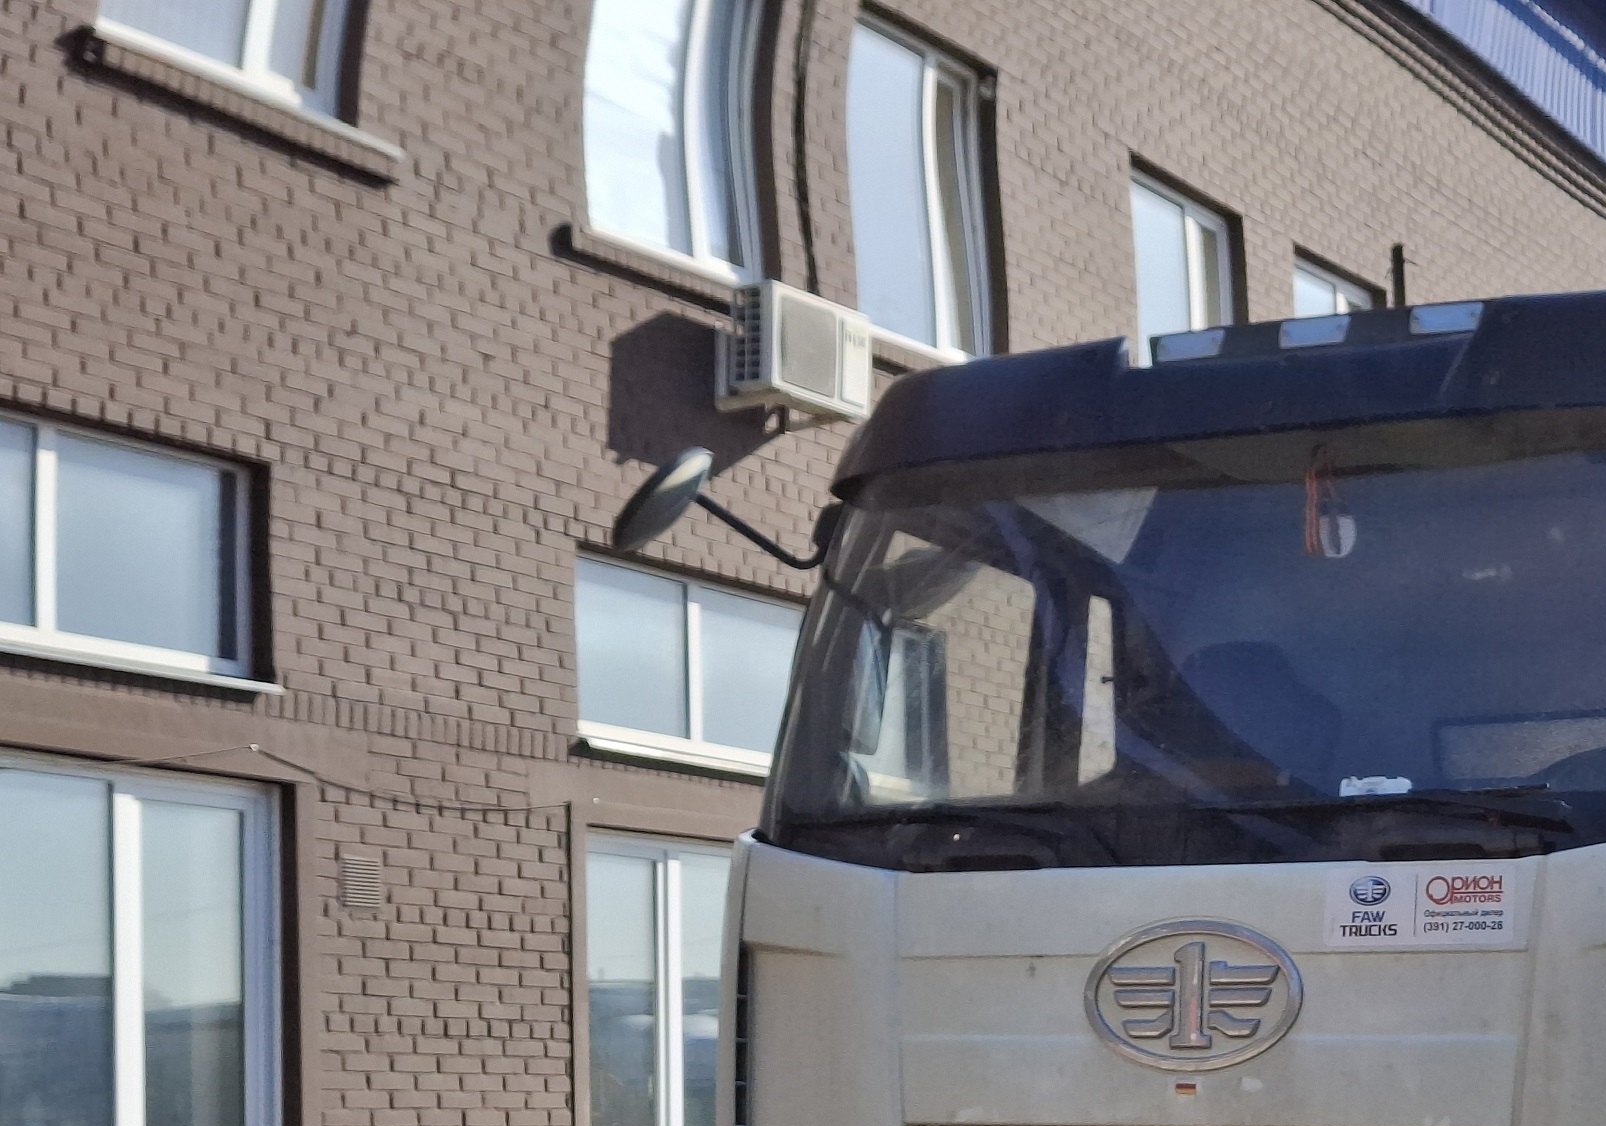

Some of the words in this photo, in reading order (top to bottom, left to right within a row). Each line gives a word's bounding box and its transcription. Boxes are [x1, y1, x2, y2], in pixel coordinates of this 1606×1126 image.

[1453, 895, 1502, 904] MOTORS
[1351, 910, 1386, 923] FAW
[1340, 924, 1397, 937] TRUCKS
